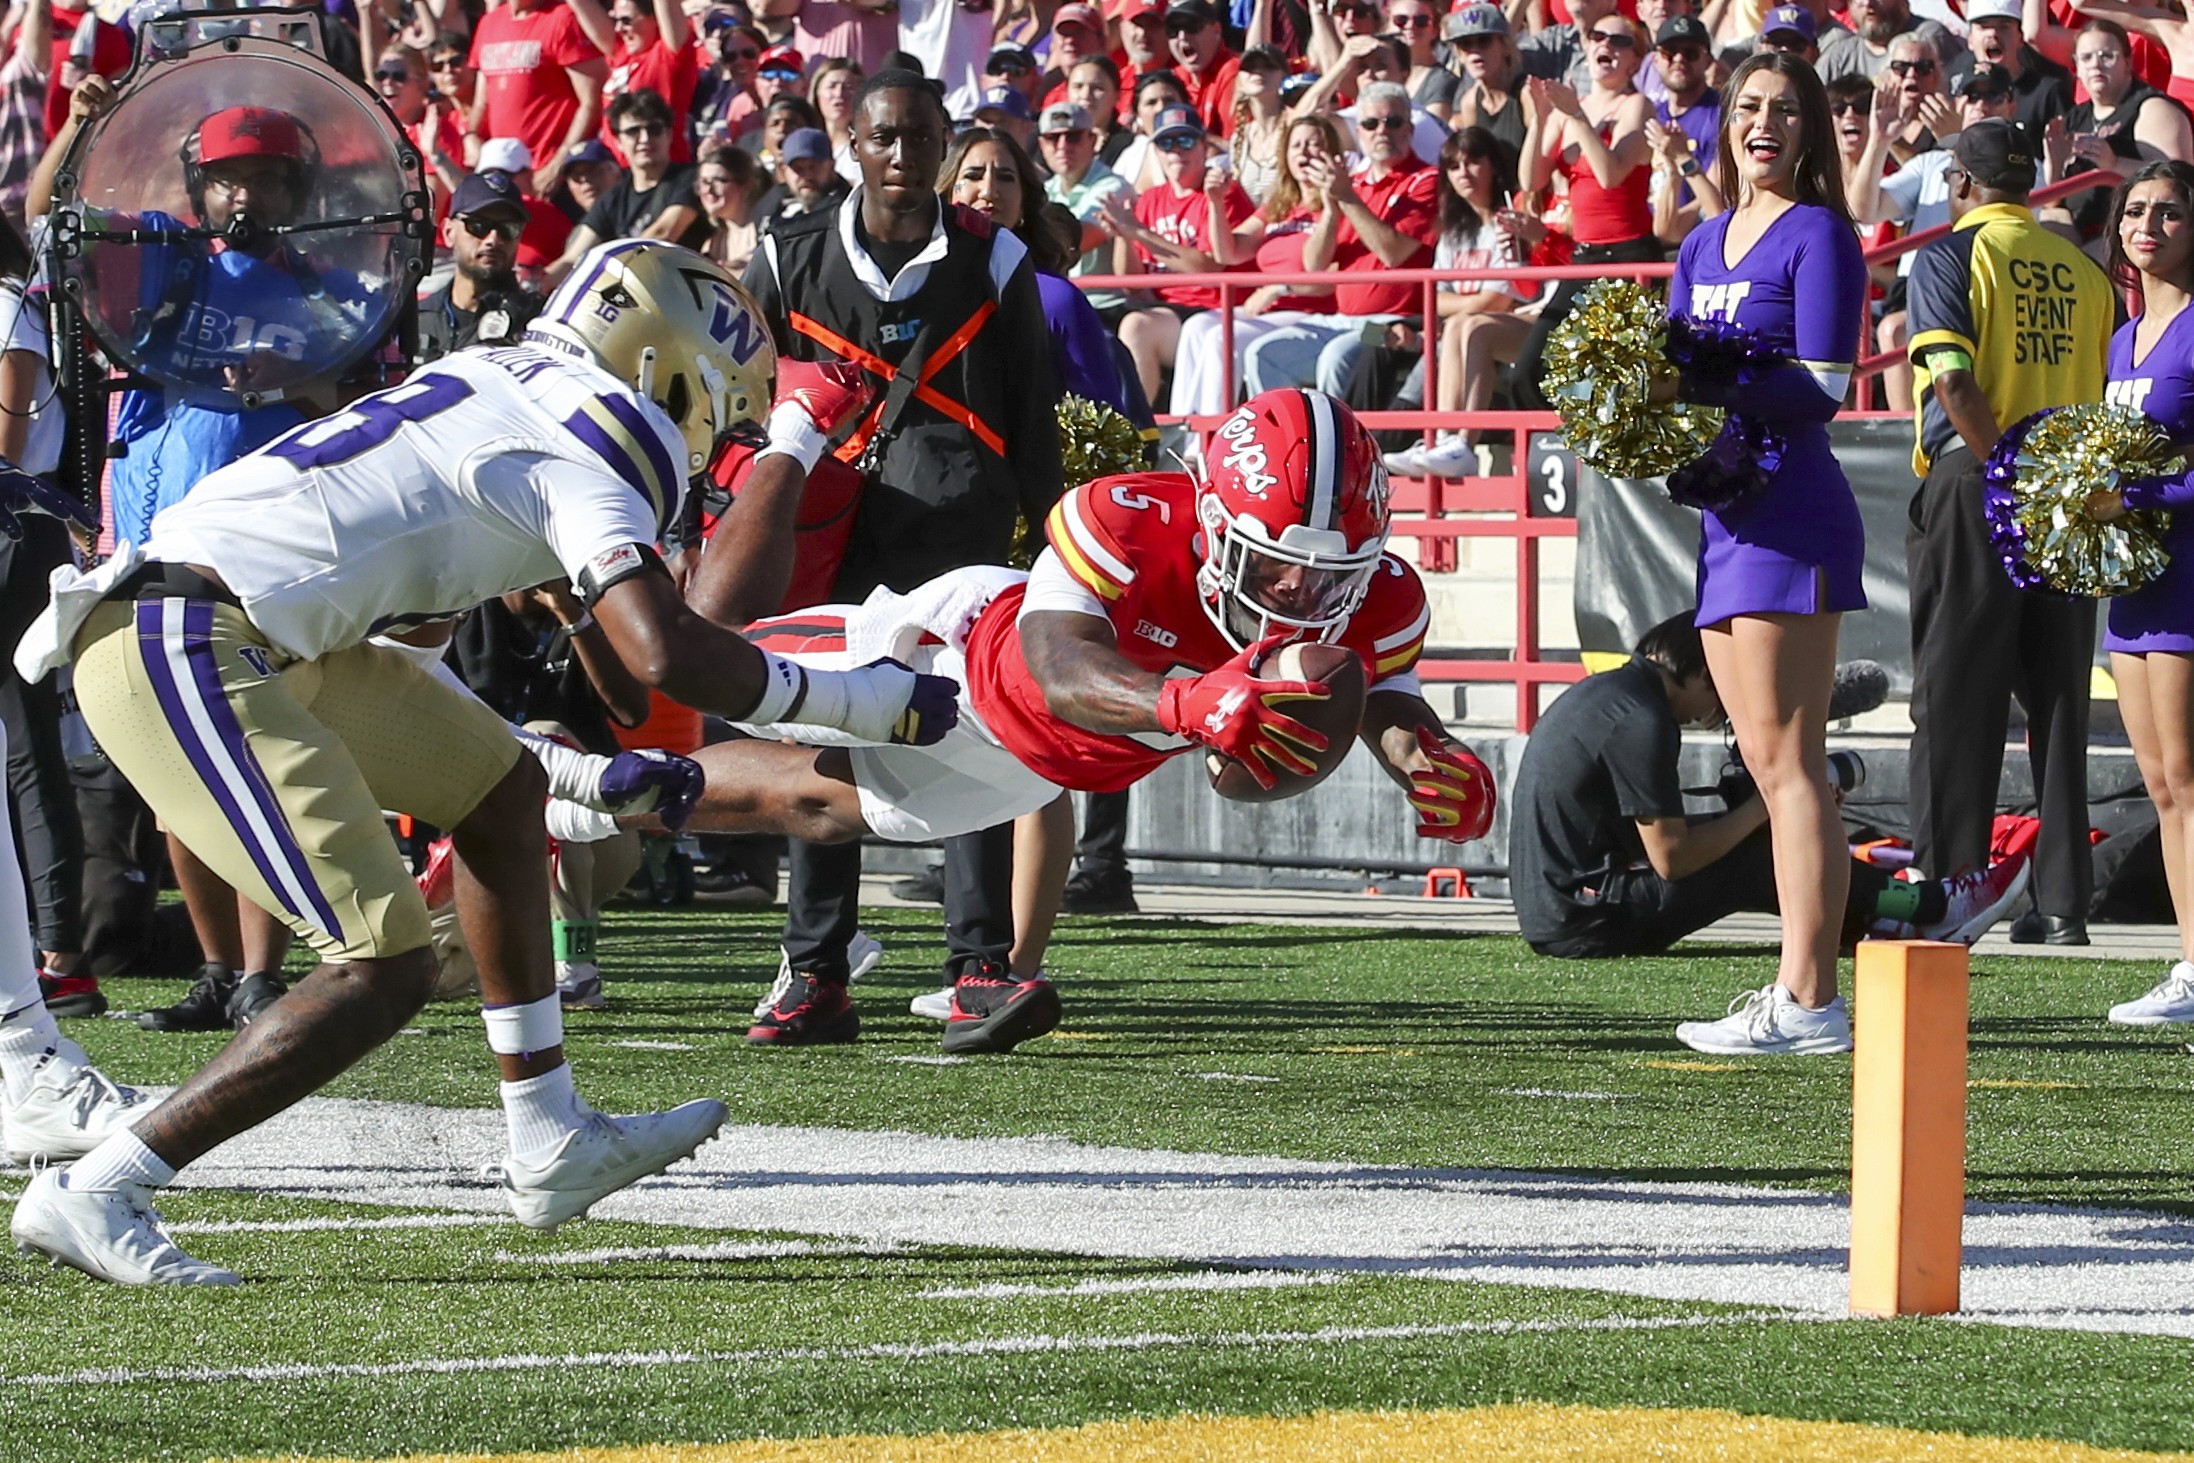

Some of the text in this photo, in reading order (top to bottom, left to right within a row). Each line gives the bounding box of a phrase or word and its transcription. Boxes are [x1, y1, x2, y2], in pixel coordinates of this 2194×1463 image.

[1462, 10, 1480, 26] W
[1777, 8, 1799, 24] W
[2008, 258, 2076, 293] CSC
[1691, 280, 1752, 325] W
[2015, 293, 2077, 331] EVENT
[710, 281, 768, 368] W
[2014, 331, 2074, 366] STAFF
[2104, 376, 2154, 412] W
[1215, 406, 1279, 501] Terps
[1540, 454, 1567, 514] 3
[1110, 485, 1171, 526] 5
